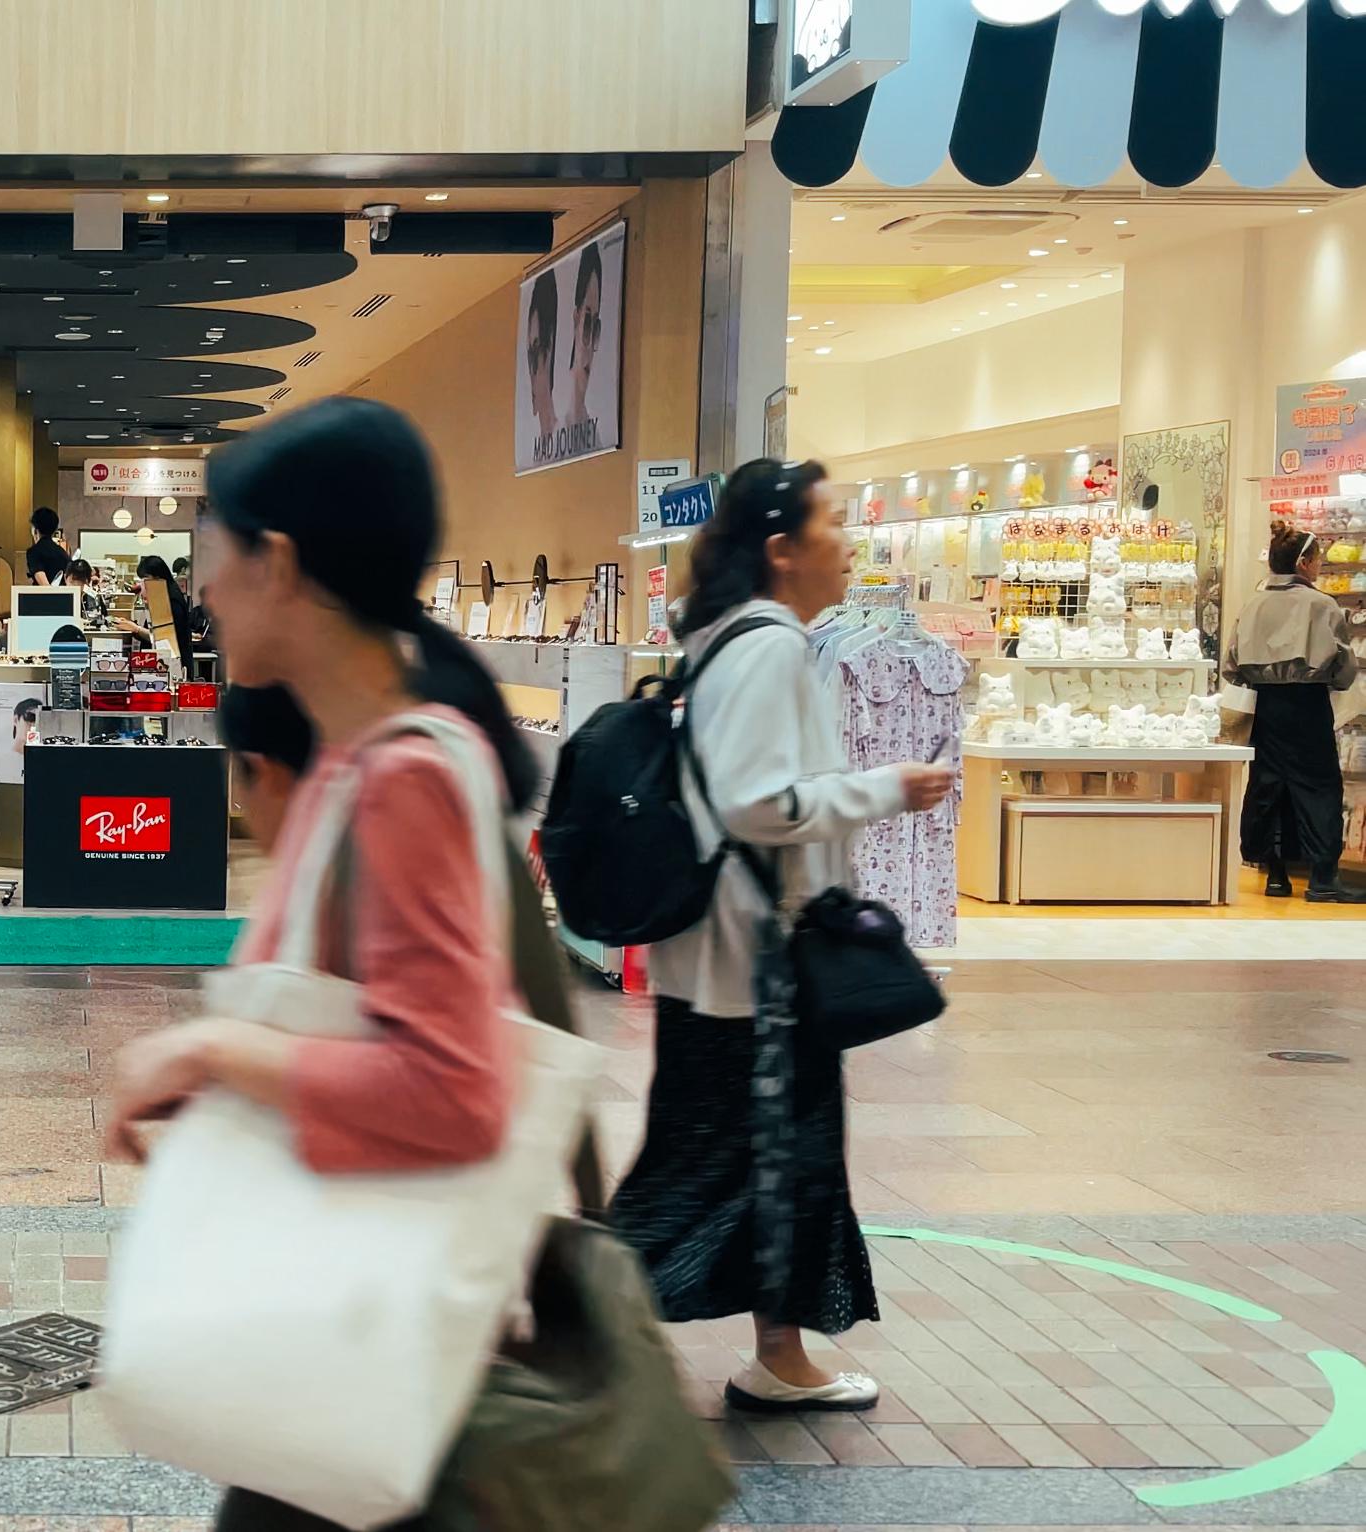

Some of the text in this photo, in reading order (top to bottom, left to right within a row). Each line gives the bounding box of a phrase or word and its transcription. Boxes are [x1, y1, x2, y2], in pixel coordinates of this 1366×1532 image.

[533, 417, 598, 462] MAD JOURNEY
[664, 493, 708, 524] コンタクト
[85, 802, 166, 845] Ray-Ban
